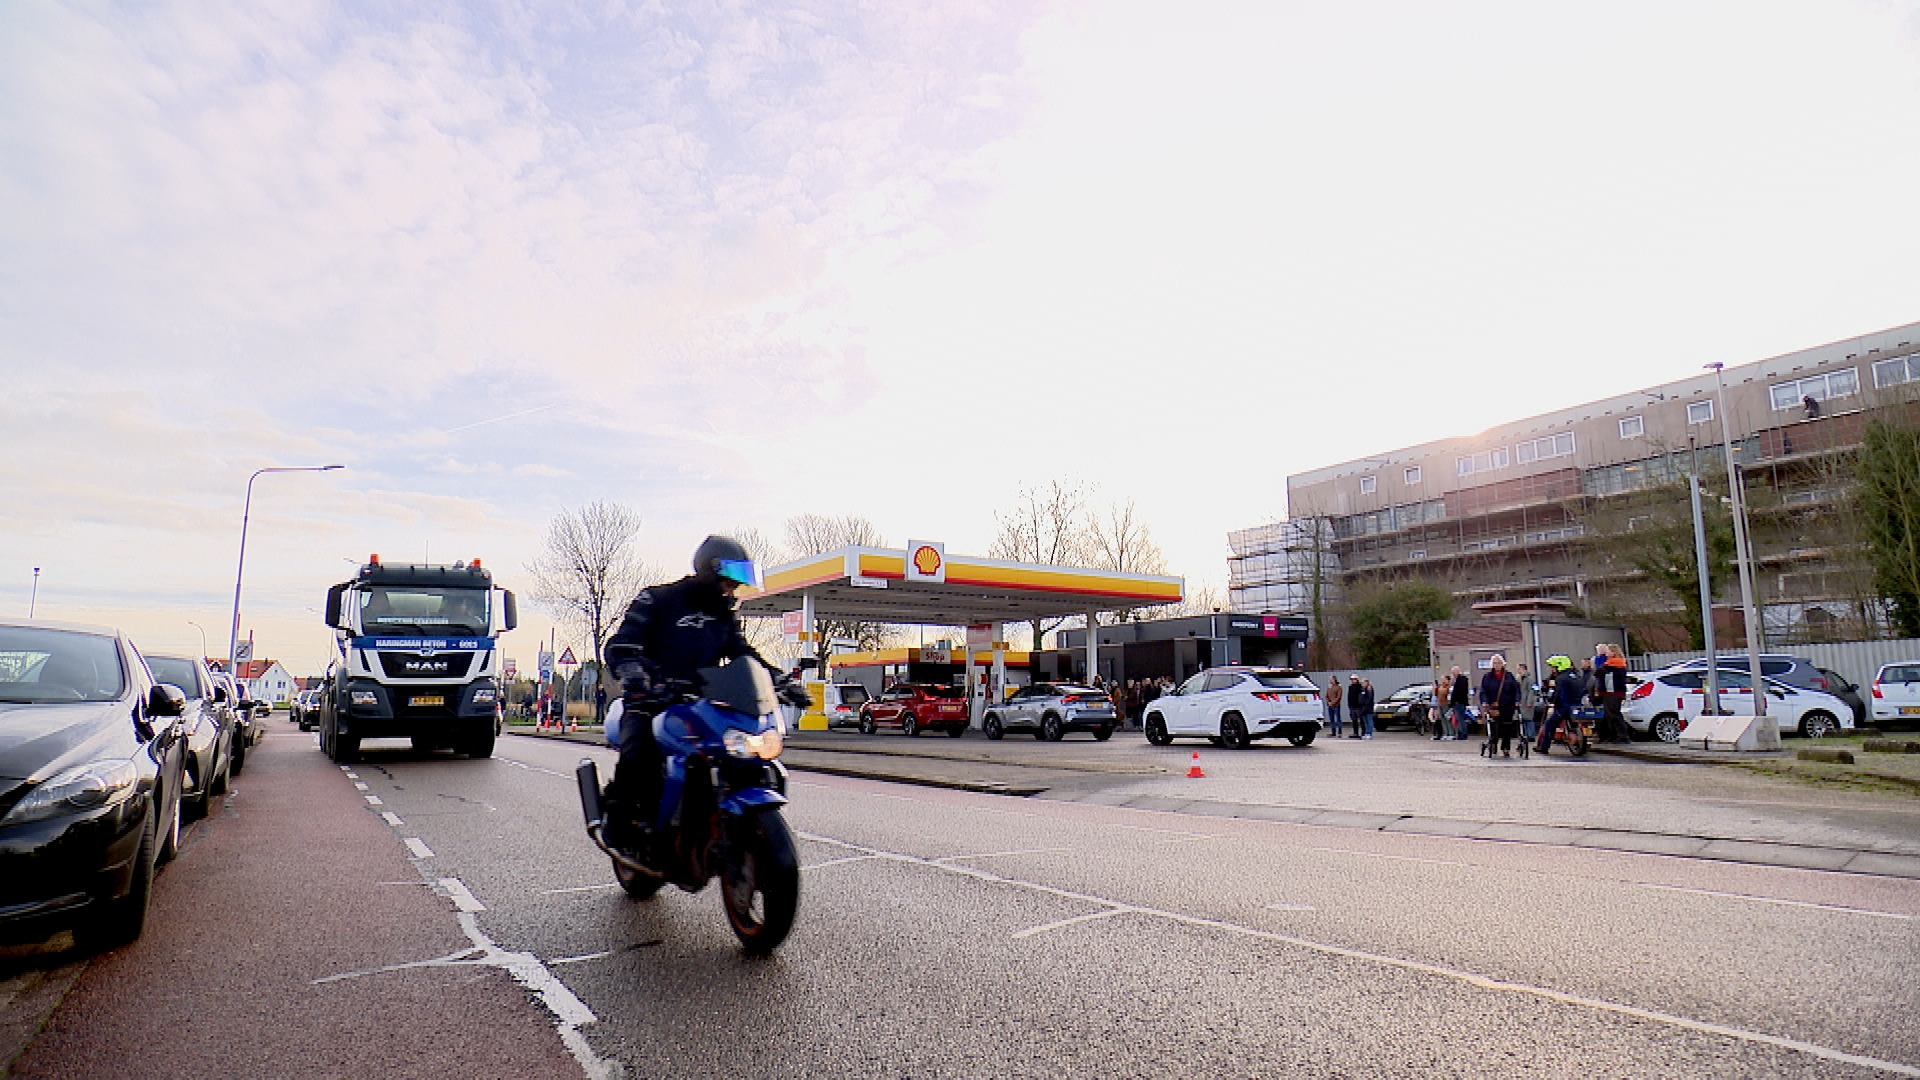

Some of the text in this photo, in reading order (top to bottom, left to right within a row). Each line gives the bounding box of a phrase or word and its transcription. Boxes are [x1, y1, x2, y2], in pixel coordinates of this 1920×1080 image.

[422, 639, 447, 647] BETON
[925, 651, 946, 661] Shop
[405, 661, 448, 671] MAN
